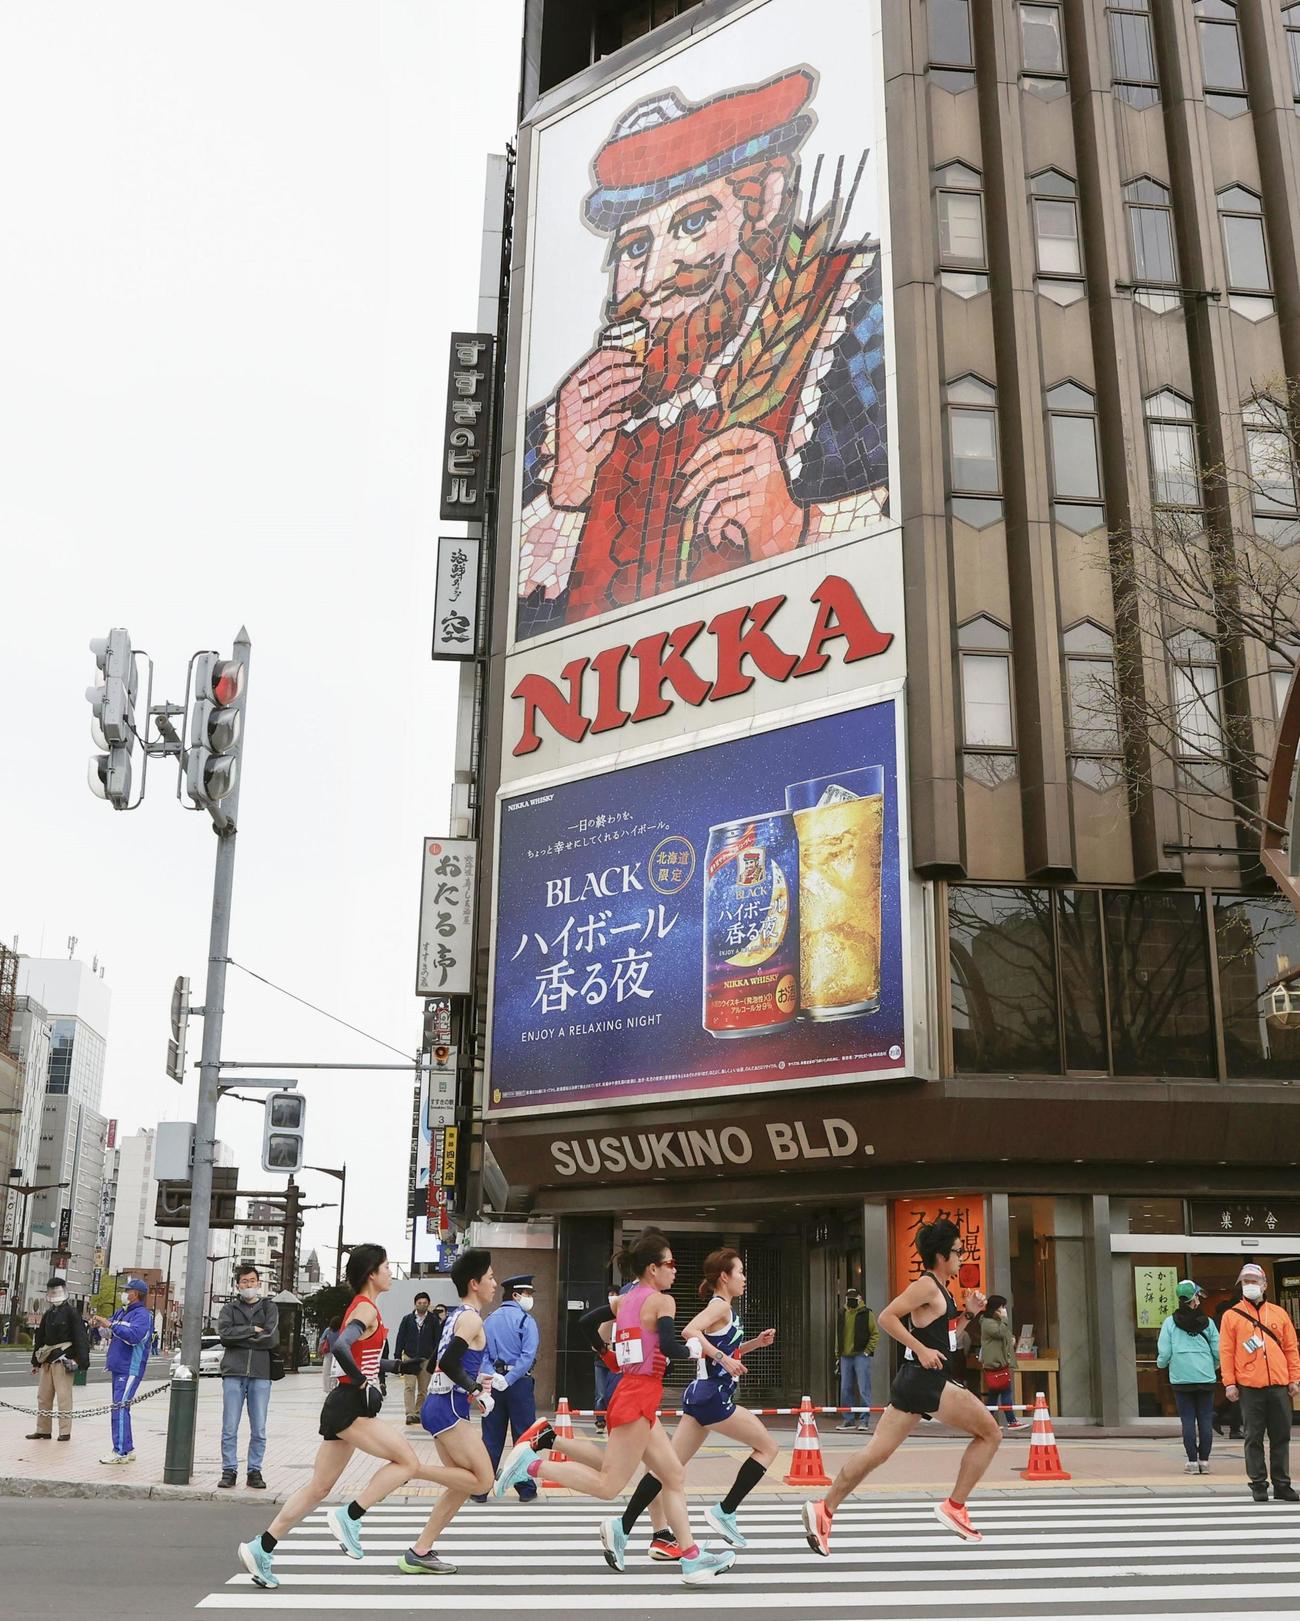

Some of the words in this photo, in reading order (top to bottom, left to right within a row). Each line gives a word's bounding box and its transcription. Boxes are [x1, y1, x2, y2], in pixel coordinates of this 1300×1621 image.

[446, 339, 486, 503] すすきのビル
[441, 609, 472, 643] 空
[511, 574, 894, 757] NIKKA
[508, 801, 529, 812] NIKKA
[530, 794, 555, 806] WHISKY
[567, 811, 634, 832] 一日の終わりを、
[527, 821, 670, 859] ちょっと幸せにしてくれるハイボール。
[656, 851, 690, 866] 北海道
[545, 862, 644, 907] BLACK
[657, 868, 683, 882] 限定
[735, 886, 768, 900] BLACK
[718, 899, 785, 922] ハイボール
[511, 904, 680, 961] ハイボール
[725, 916, 777, 946] 香る夜
[530, 947, 655, 1014] 香る夜
[724, 978, 749, 989] NIKKA
[750, 973, 779, 985] WHISKY
[521, 1027, 555, 1042] ENJOY
[558, 1027, 566, 1038] A
[569, 1018, 622, 1036] RELAXING
[626, 1013, 662, 1029] NIGHT
[438, 1116, 445, 1124] 3
[550, 1125, 753, 1176] SUSUKINO
[765, 1117, 876, 1162] BLD.
[954, 1208, 981, 1261] 札幌
[1220, 1210, 1278, 1230] 菓か舎
